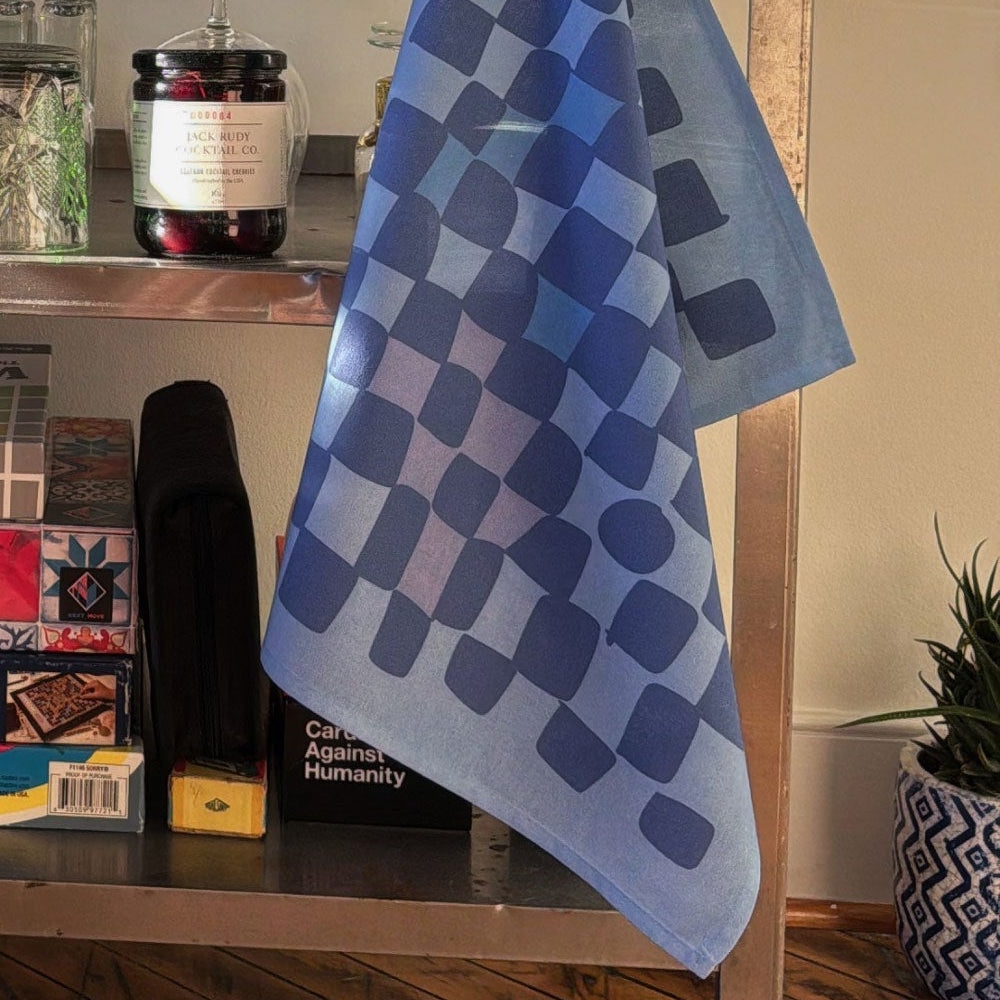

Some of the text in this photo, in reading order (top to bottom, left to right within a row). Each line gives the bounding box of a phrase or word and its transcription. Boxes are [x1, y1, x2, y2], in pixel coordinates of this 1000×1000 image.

[187, 131, 251, 143] JACK RUDY
[306, 720, 357, 740] Car
[304, 742, 385, 763] Against
[304, 761, 405, 788] Humanity
